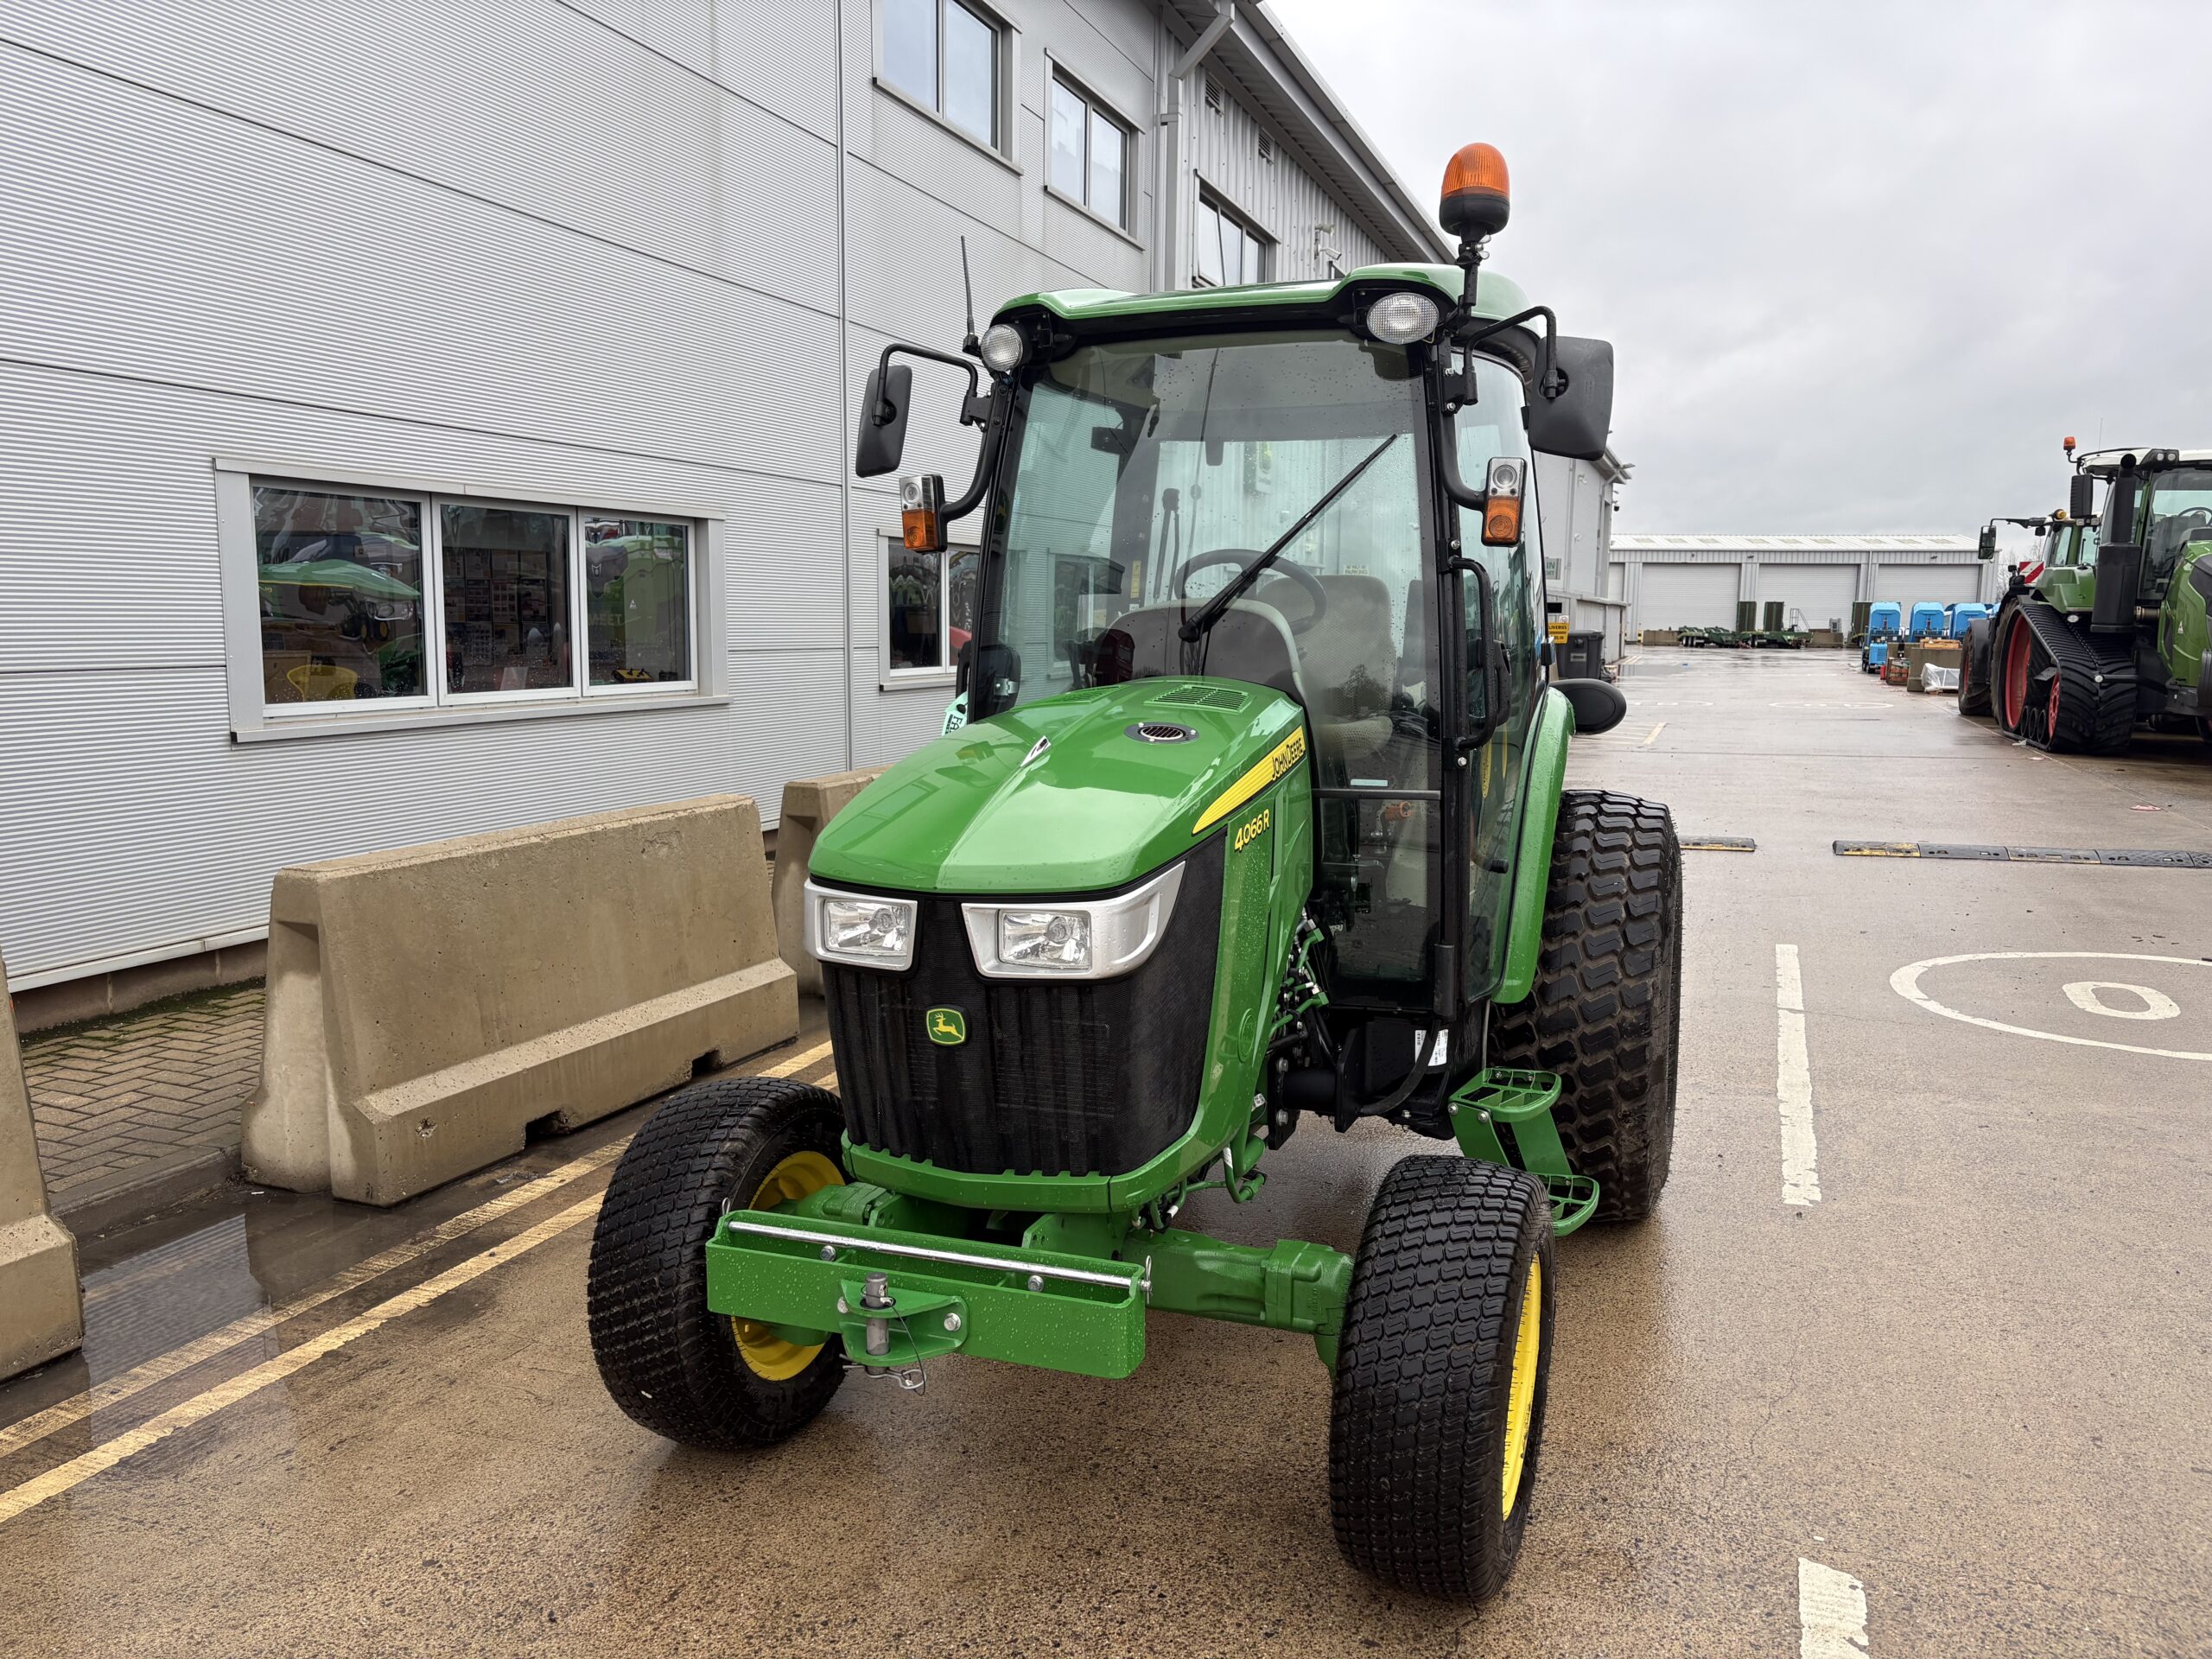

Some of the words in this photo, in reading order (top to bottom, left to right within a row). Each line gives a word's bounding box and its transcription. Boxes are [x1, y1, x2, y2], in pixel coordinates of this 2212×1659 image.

[1272, 750, 1289, 779] JOHN
[1287, 738, 1303, 764] DEERE
[1235, 809, 1269, 852] 4066R
